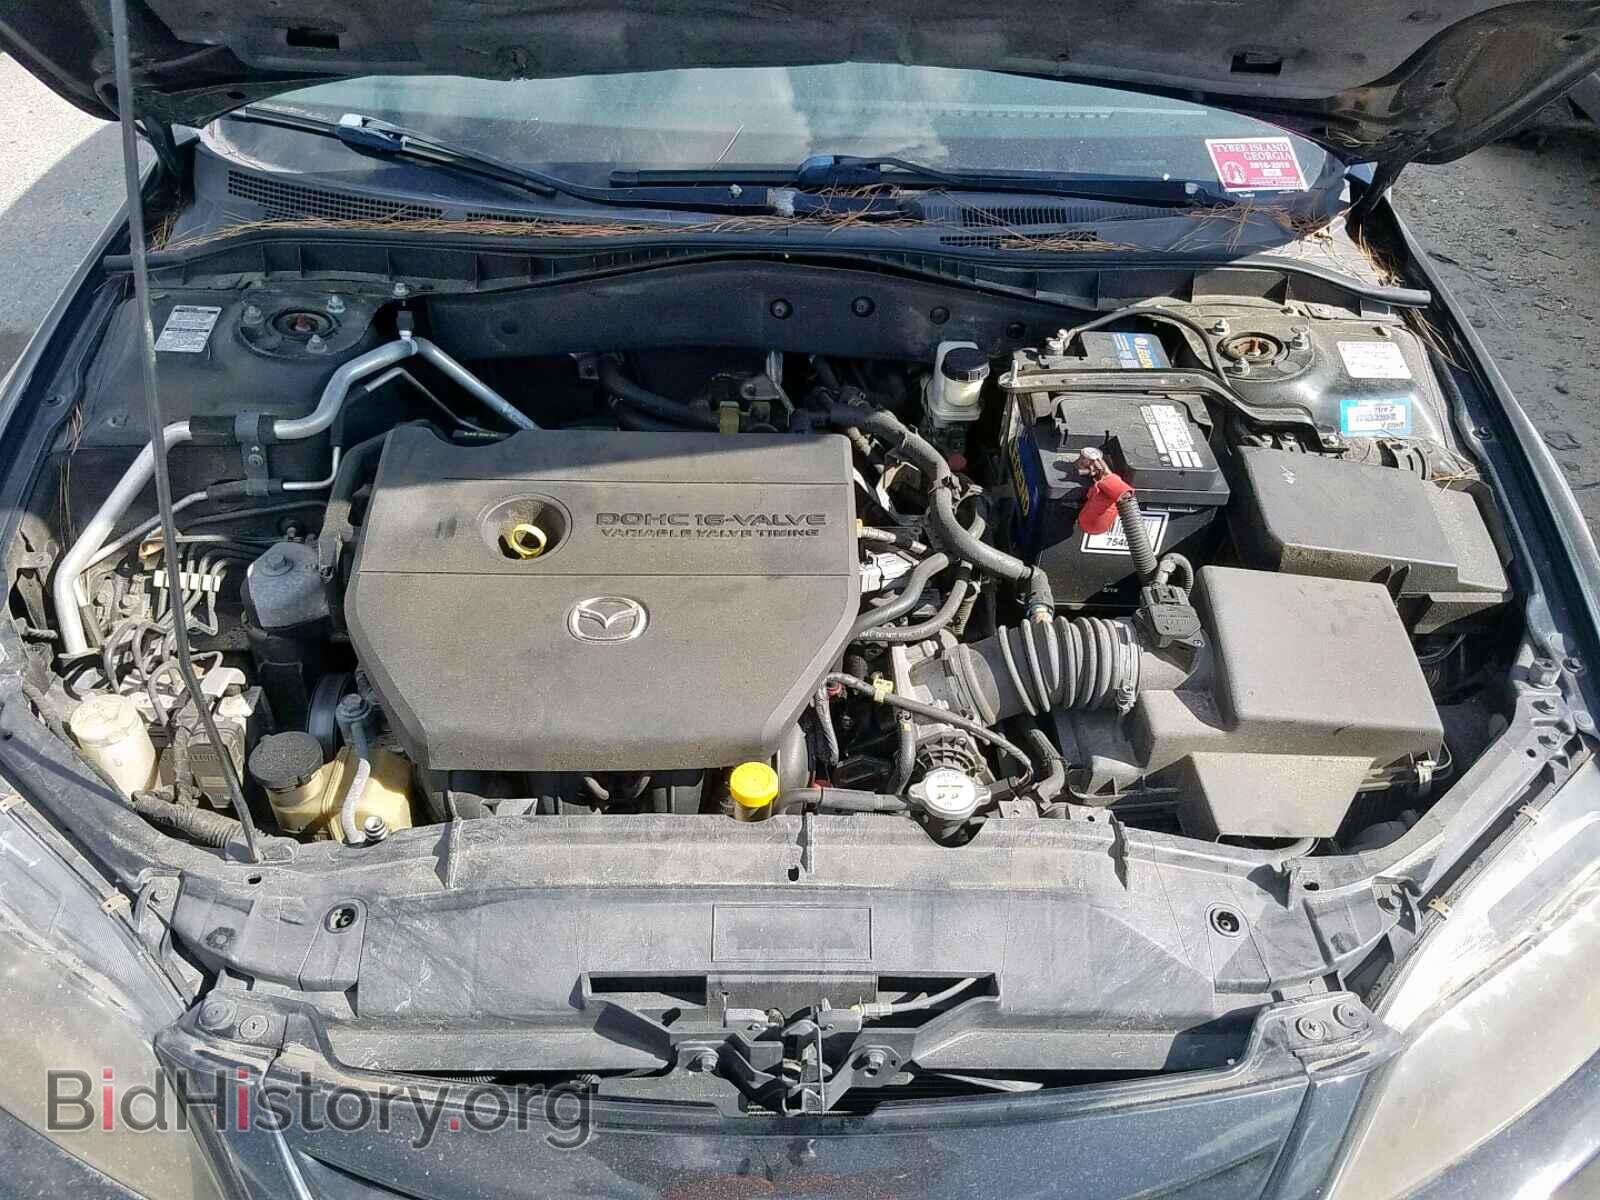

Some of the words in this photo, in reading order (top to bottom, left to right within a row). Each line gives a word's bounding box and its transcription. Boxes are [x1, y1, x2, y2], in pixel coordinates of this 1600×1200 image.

[1213, 144, 1249, 153] TYBEE
[1250, 143, 1290, 152] ISLAND
[1243, 151, 1295, 161] GEORGIA
[595, 512, 691, 527] DOHC
[694, 513, 827, 527] 16-VALVE
[600, 528, 692, 538] VARIABLE
[696, 529, 752, 538] VALVE
[756, 529, 820, 538] TIMING
